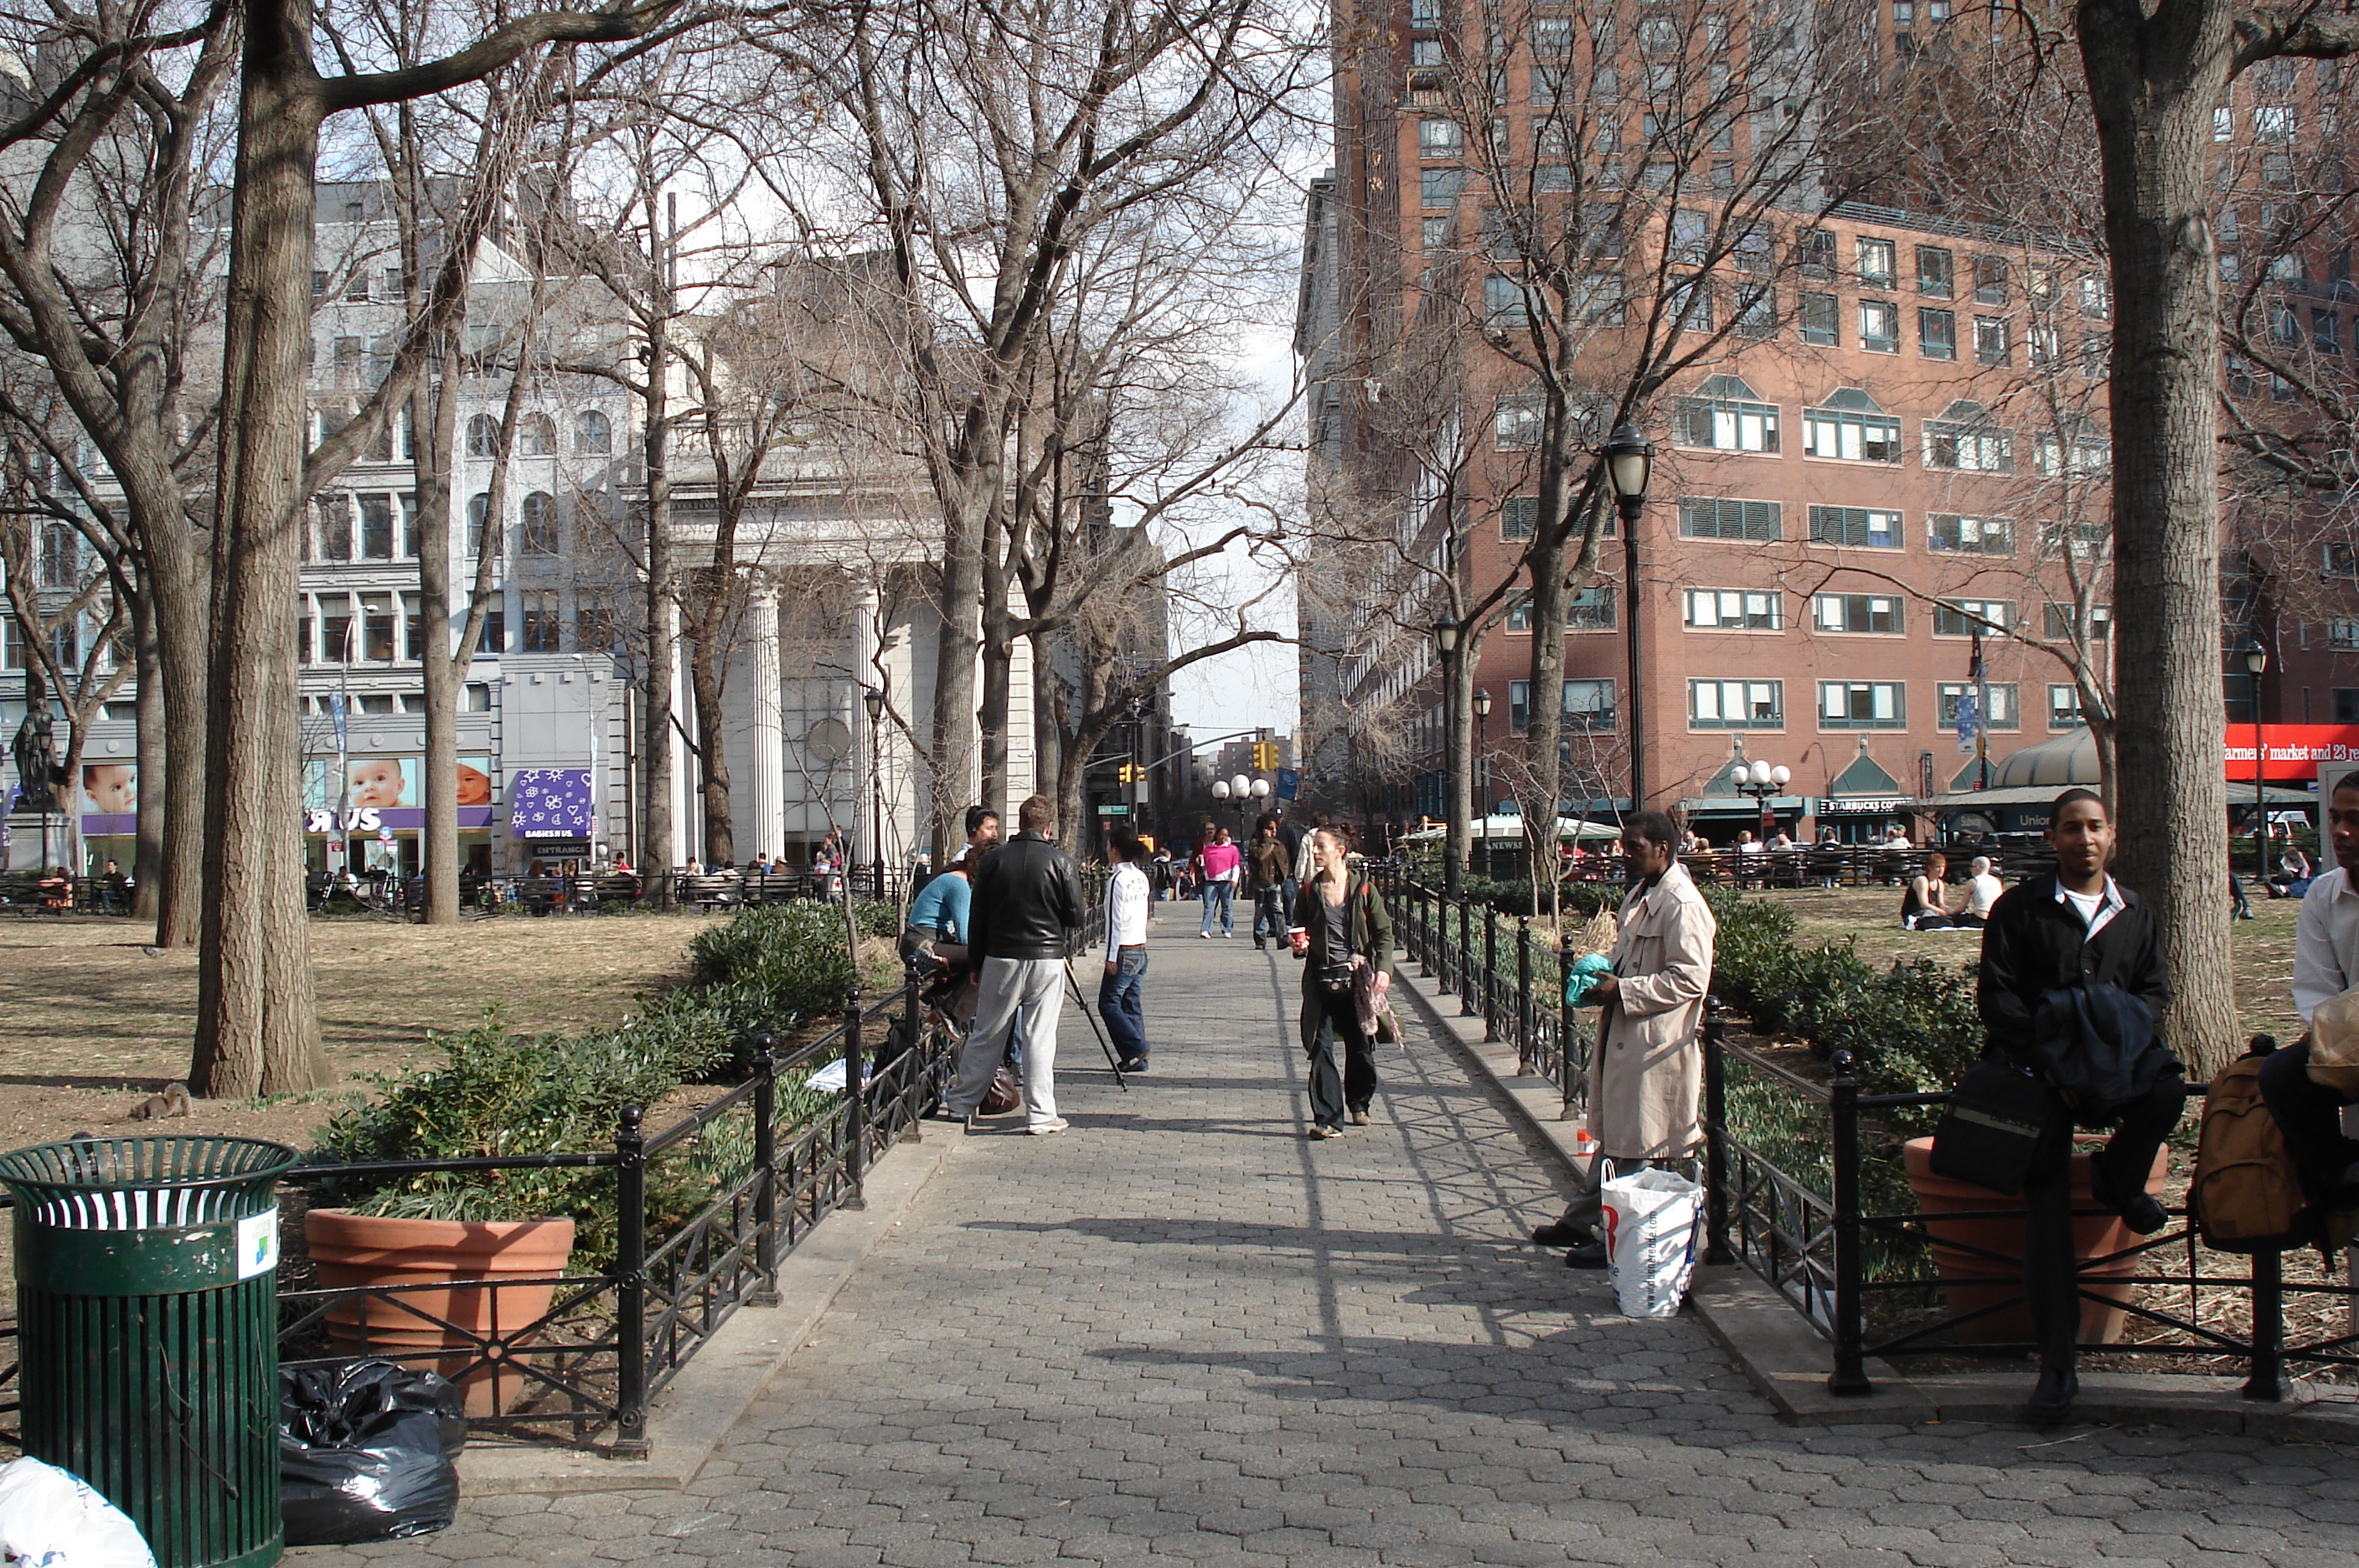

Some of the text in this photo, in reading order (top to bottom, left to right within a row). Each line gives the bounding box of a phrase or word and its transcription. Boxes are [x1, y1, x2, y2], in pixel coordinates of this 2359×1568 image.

[2223, 743, 2269, 761] armers'
[2269, 743, 2310, 761] market
[2311, 743, 2331, 761] and
[2333, 744, 2346, 760] 23
[1829, 801, 1880, 811] STARBUCKS
[524, 829, 554, 838] BABIES
